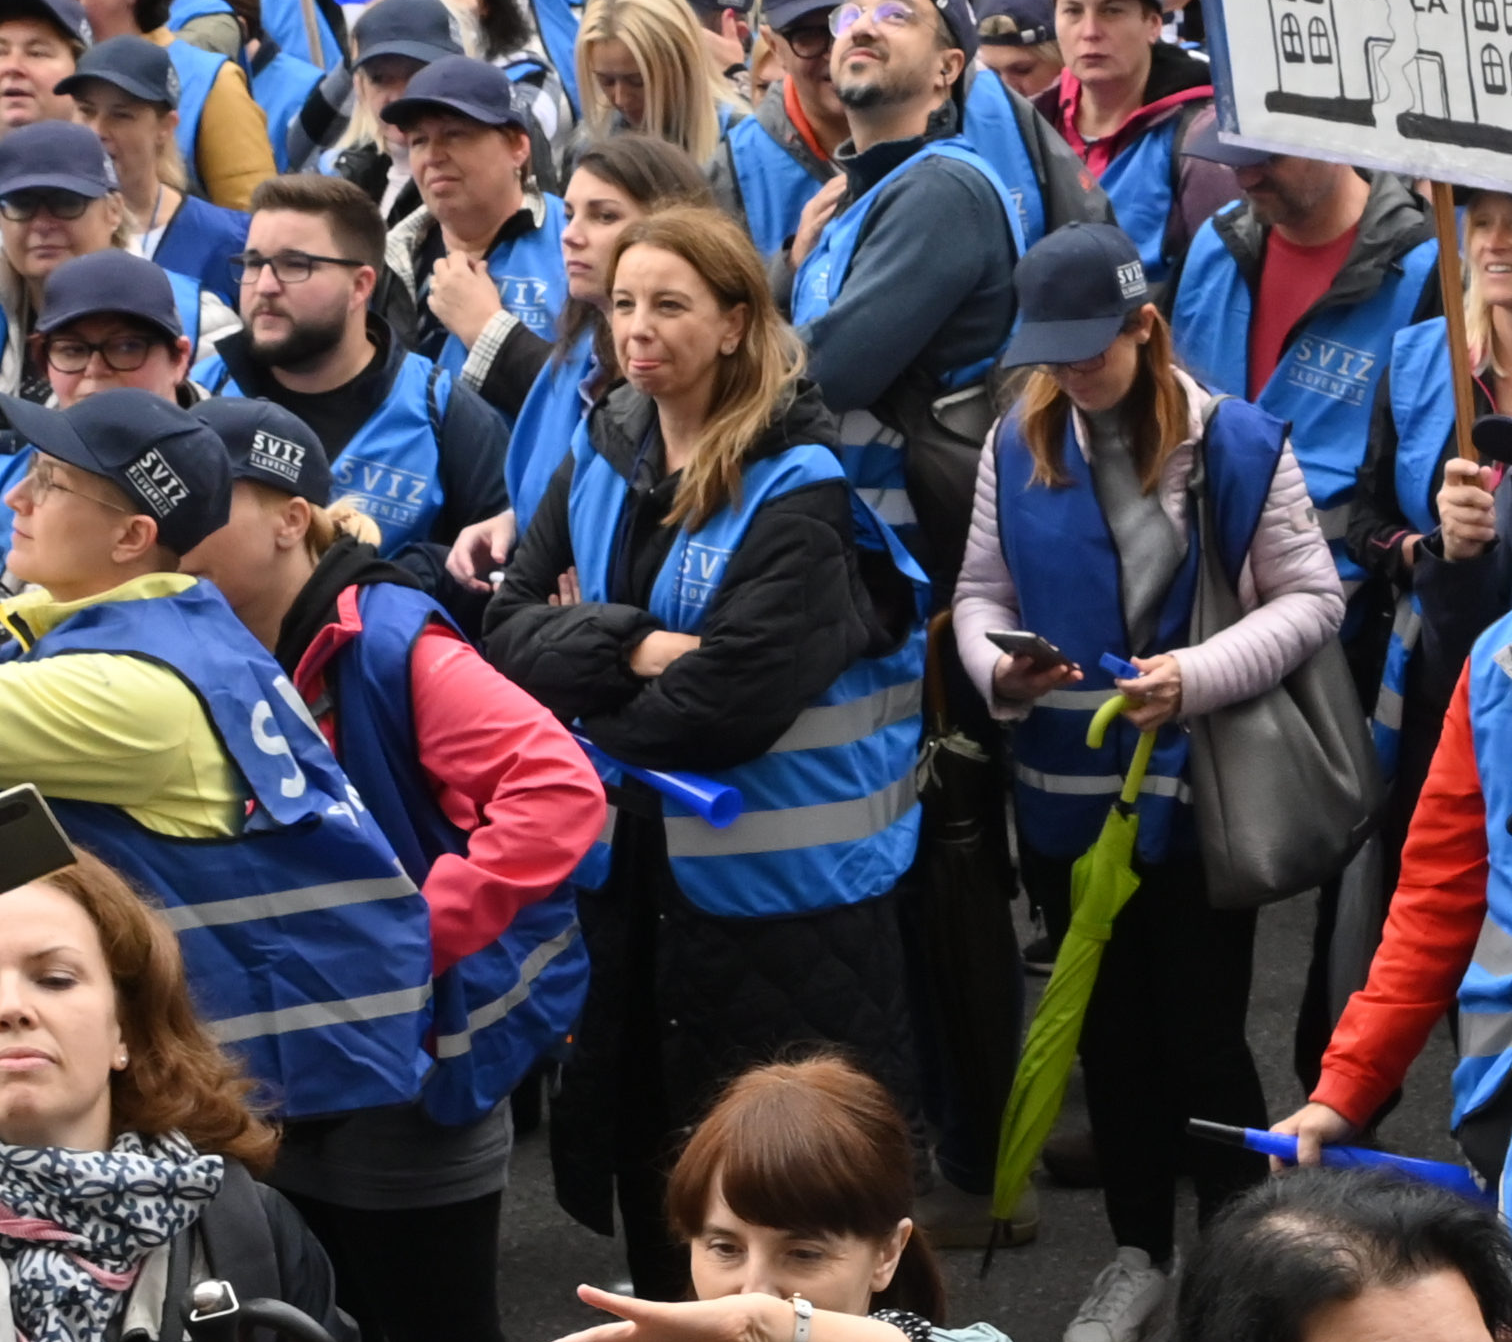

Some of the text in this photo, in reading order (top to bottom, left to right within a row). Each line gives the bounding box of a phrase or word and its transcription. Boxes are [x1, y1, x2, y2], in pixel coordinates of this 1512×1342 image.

[1296, 338, 1375, 381] SVIZ
[253, 434, 305, 467] SVIZ
[140, 452, 187, 506] SVIZ
[339, 461, 426, 504] SVIZ
